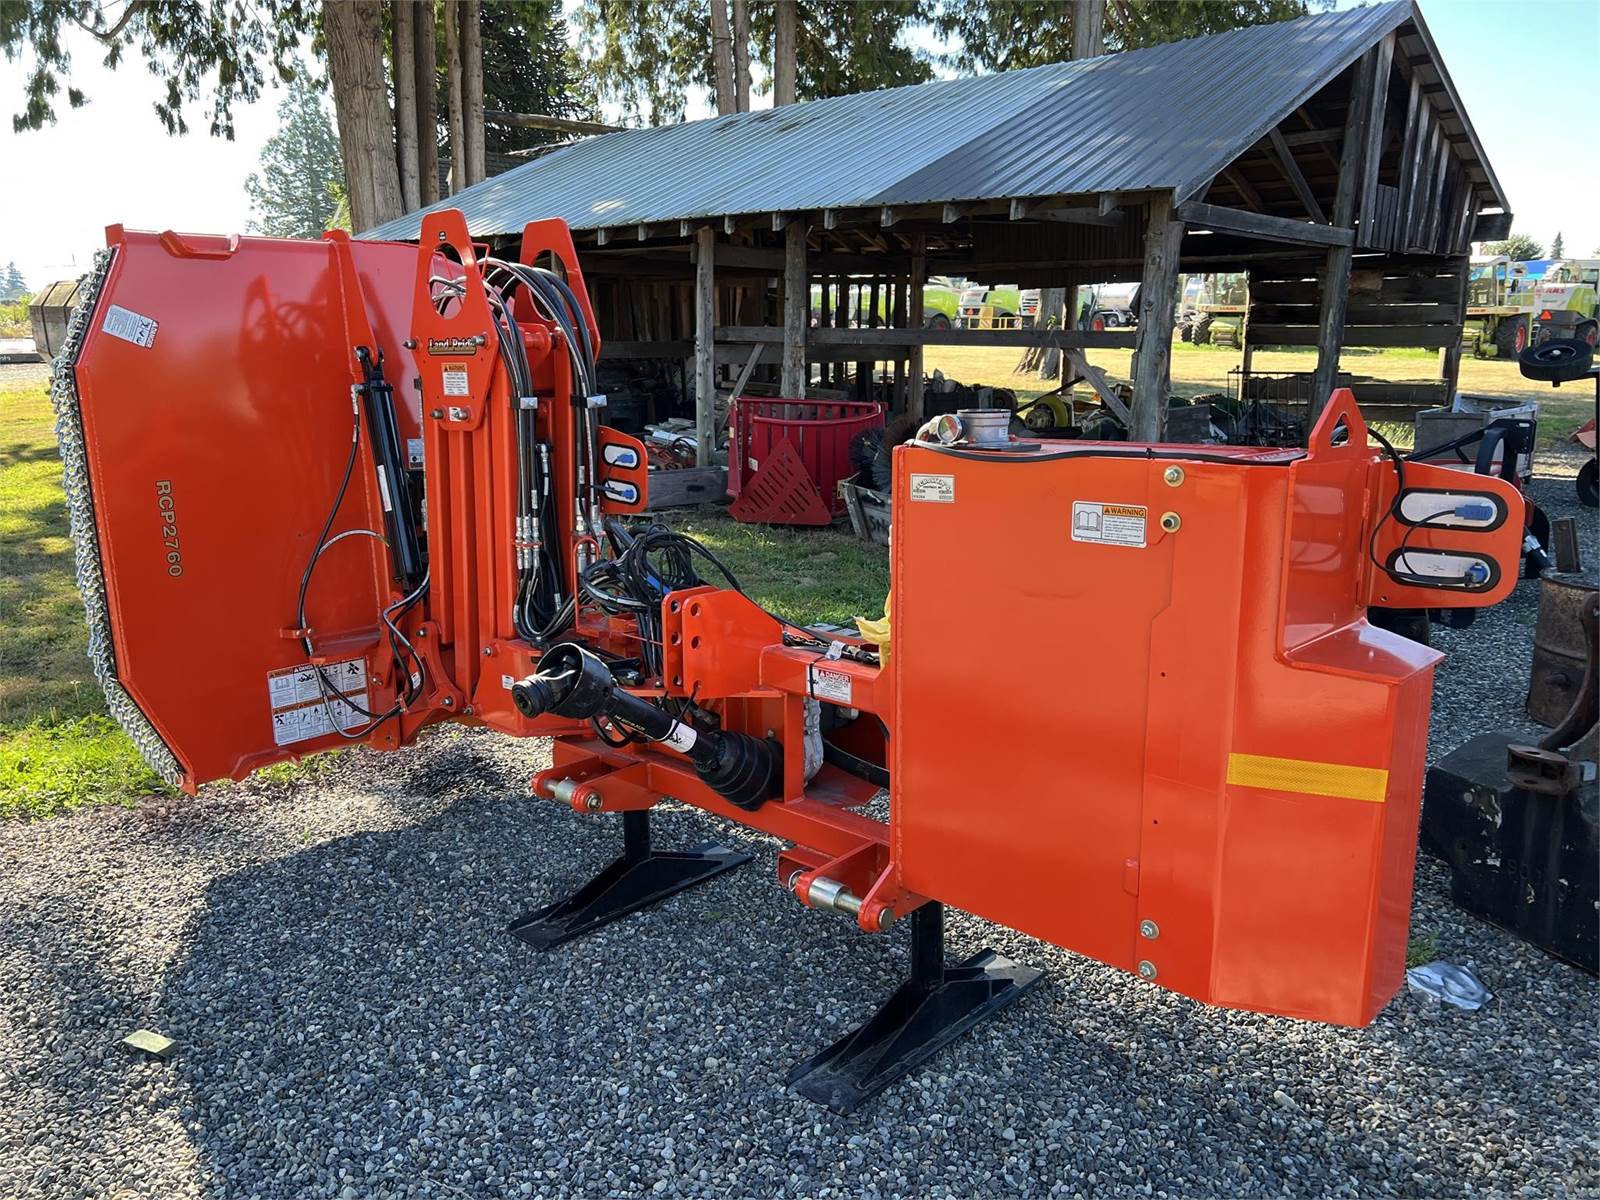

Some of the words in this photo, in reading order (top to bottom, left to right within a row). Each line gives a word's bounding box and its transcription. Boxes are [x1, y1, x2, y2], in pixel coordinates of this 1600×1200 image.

[429, 338, 449, 348] Land
[1111, 507, 1144, 517] WARNING
[155, 480, 183, 577] RCP2760
[825, 671, 849, 681] DANGER
